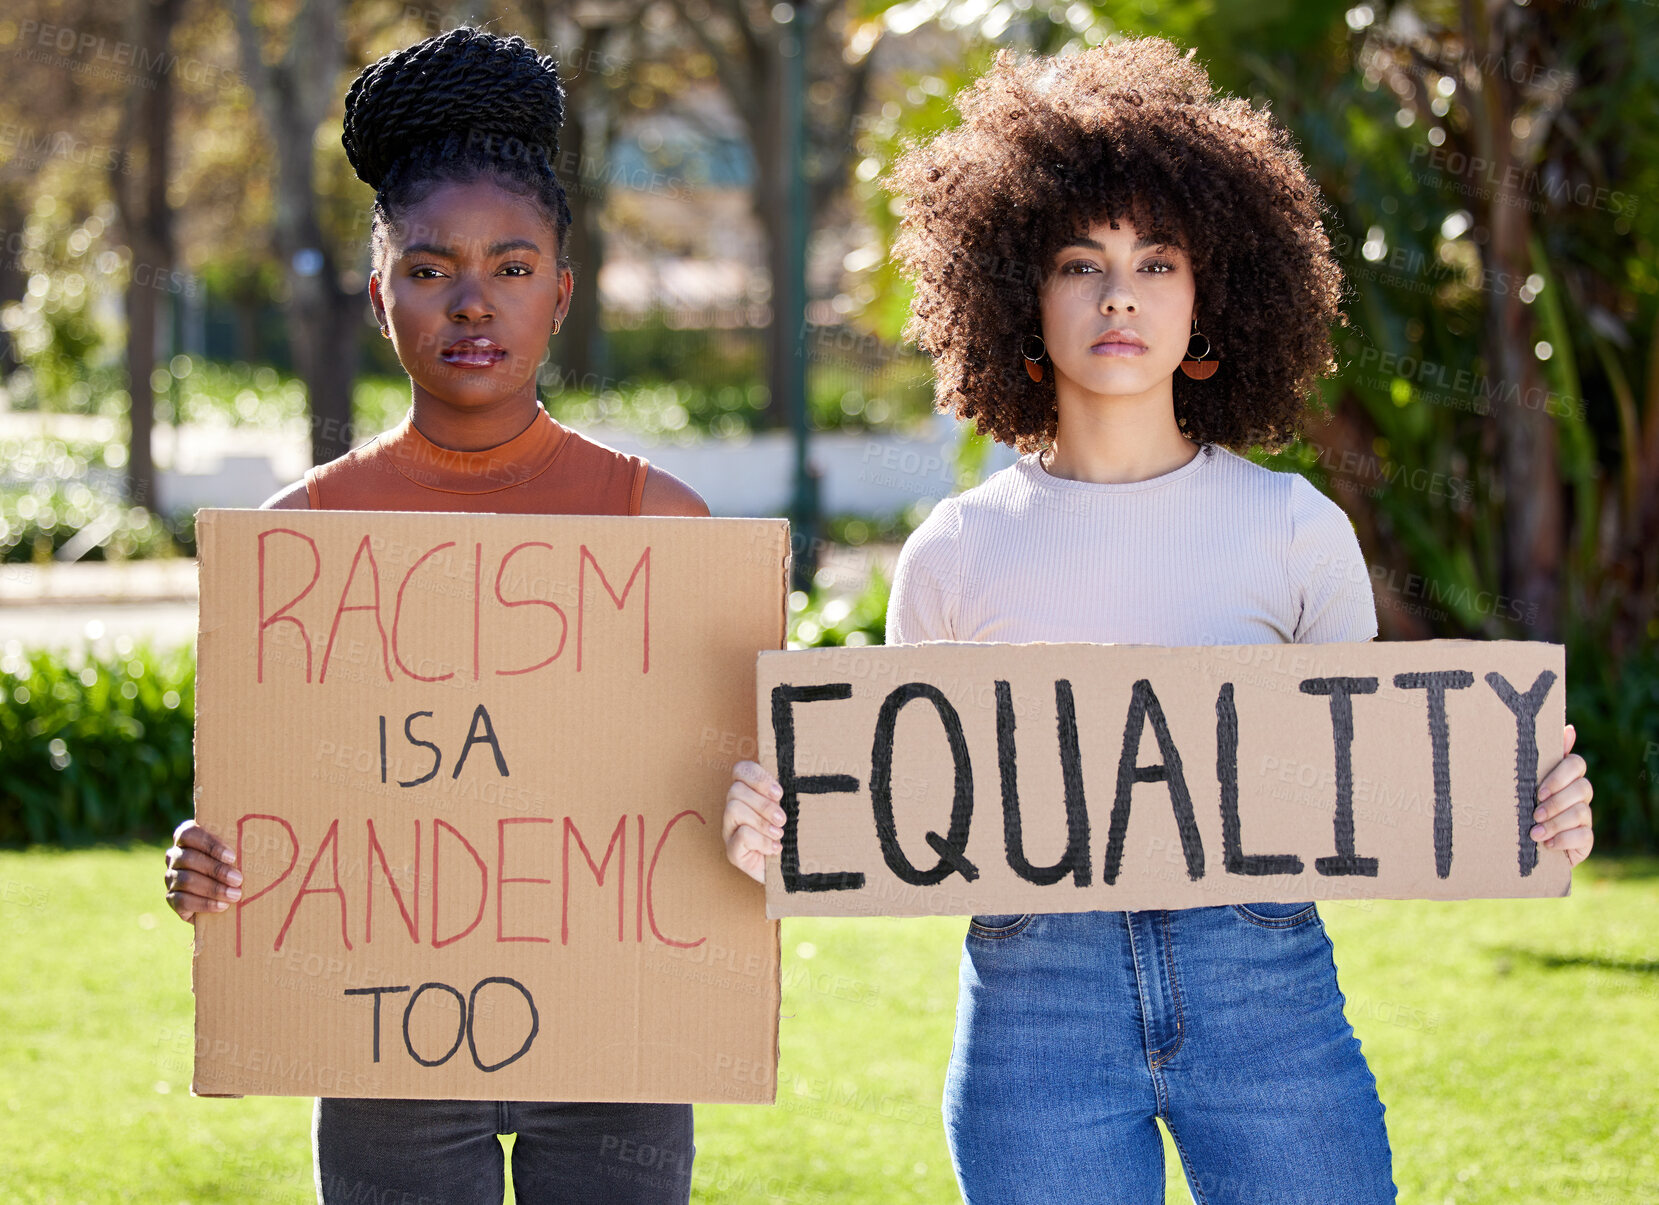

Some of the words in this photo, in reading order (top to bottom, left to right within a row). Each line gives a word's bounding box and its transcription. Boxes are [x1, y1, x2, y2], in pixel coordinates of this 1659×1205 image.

[257, 528, 651, 684] RACISM
[379, 711, 441, 788] IS
[453, 704, 510, 780] A
[770, 670, 1562, 894] EQUALITY
[234, 811, 707, 958] PANDEMIC
[344, 977, 539, 1073] TOO
